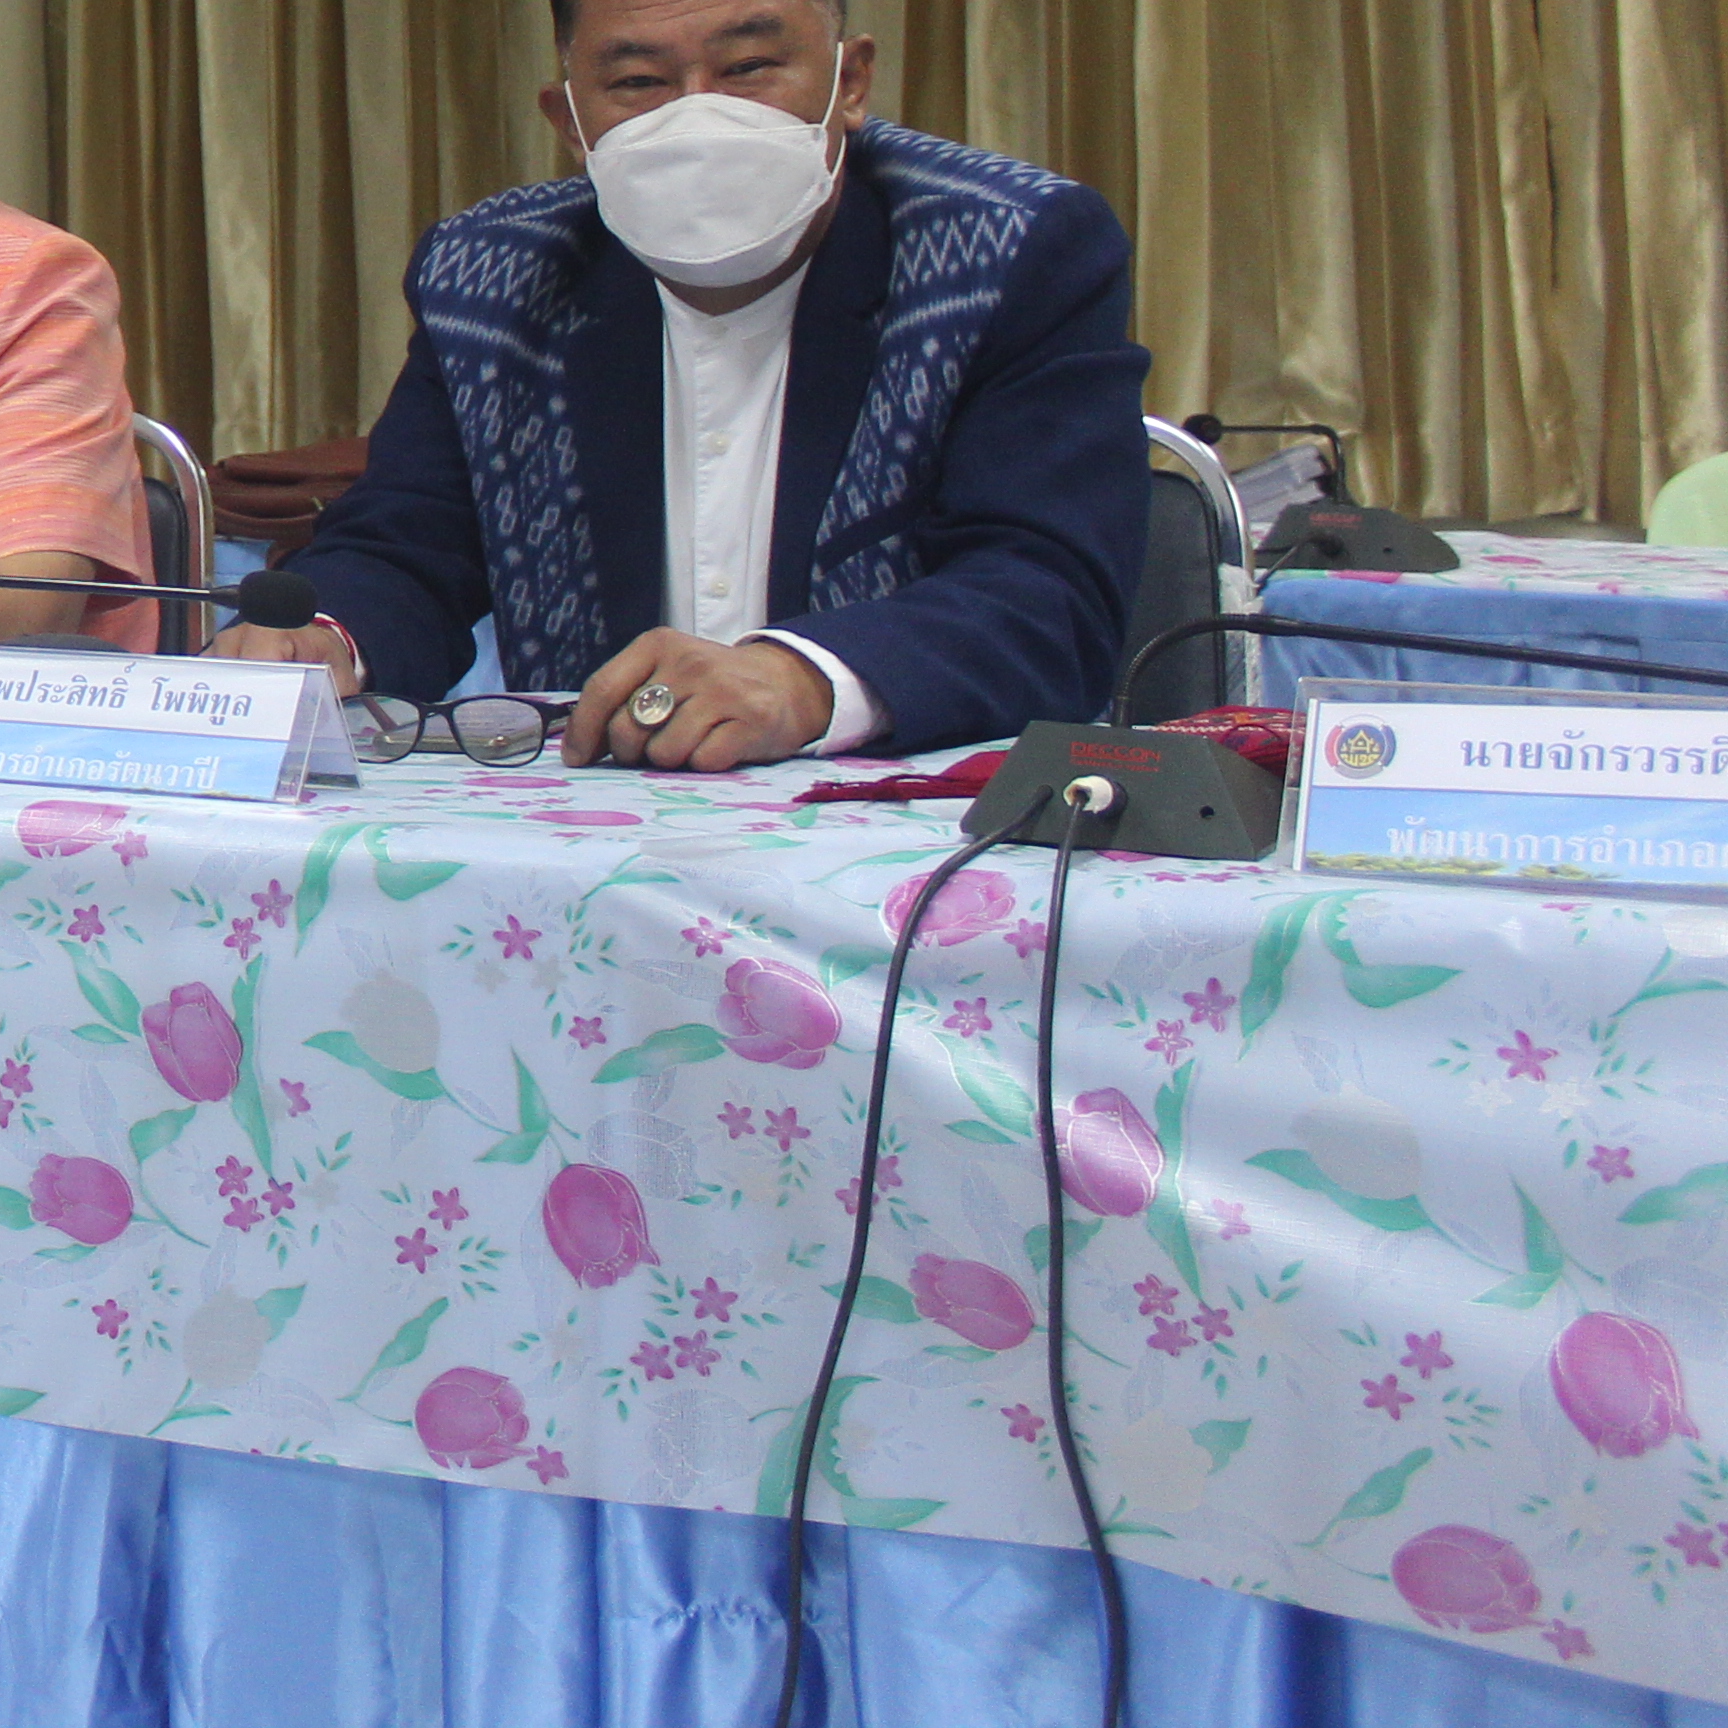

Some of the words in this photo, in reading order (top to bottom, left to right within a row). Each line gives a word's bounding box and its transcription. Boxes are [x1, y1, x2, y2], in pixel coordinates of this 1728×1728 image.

[149, 676, 253, 726] โพพิทูล
[1070, 740, 1162, 763] DECCON
[1386, 815, 1728, 869] พัฒนาการอำเภอ
